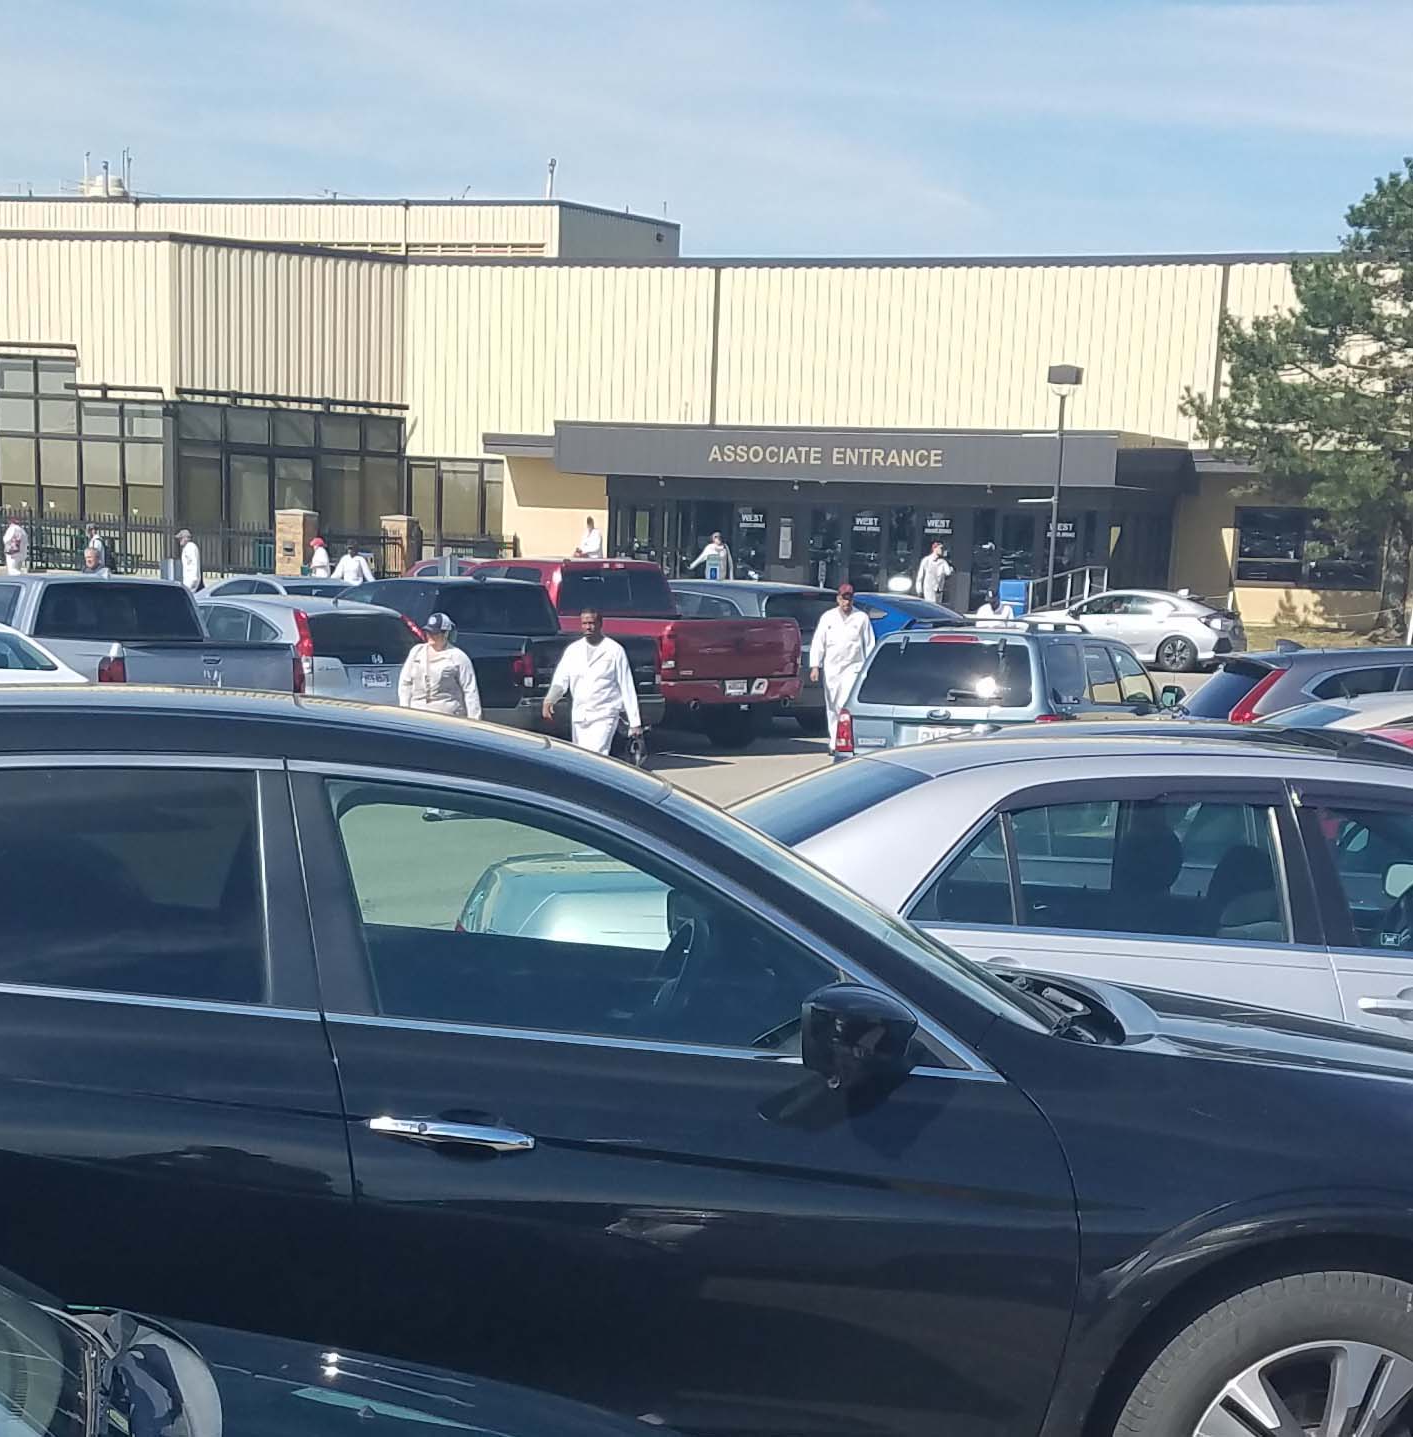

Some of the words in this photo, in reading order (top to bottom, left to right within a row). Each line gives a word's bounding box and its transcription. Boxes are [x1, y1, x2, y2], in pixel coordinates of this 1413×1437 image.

[708, 445, 822, 465] ASSOCIATE
[832, 447, 943, 467] ENTRANCE
[741, 513, 764, 523] WEST
[855, 517, 879, 526] WEST
[926, 519, 951, 528] WEST
